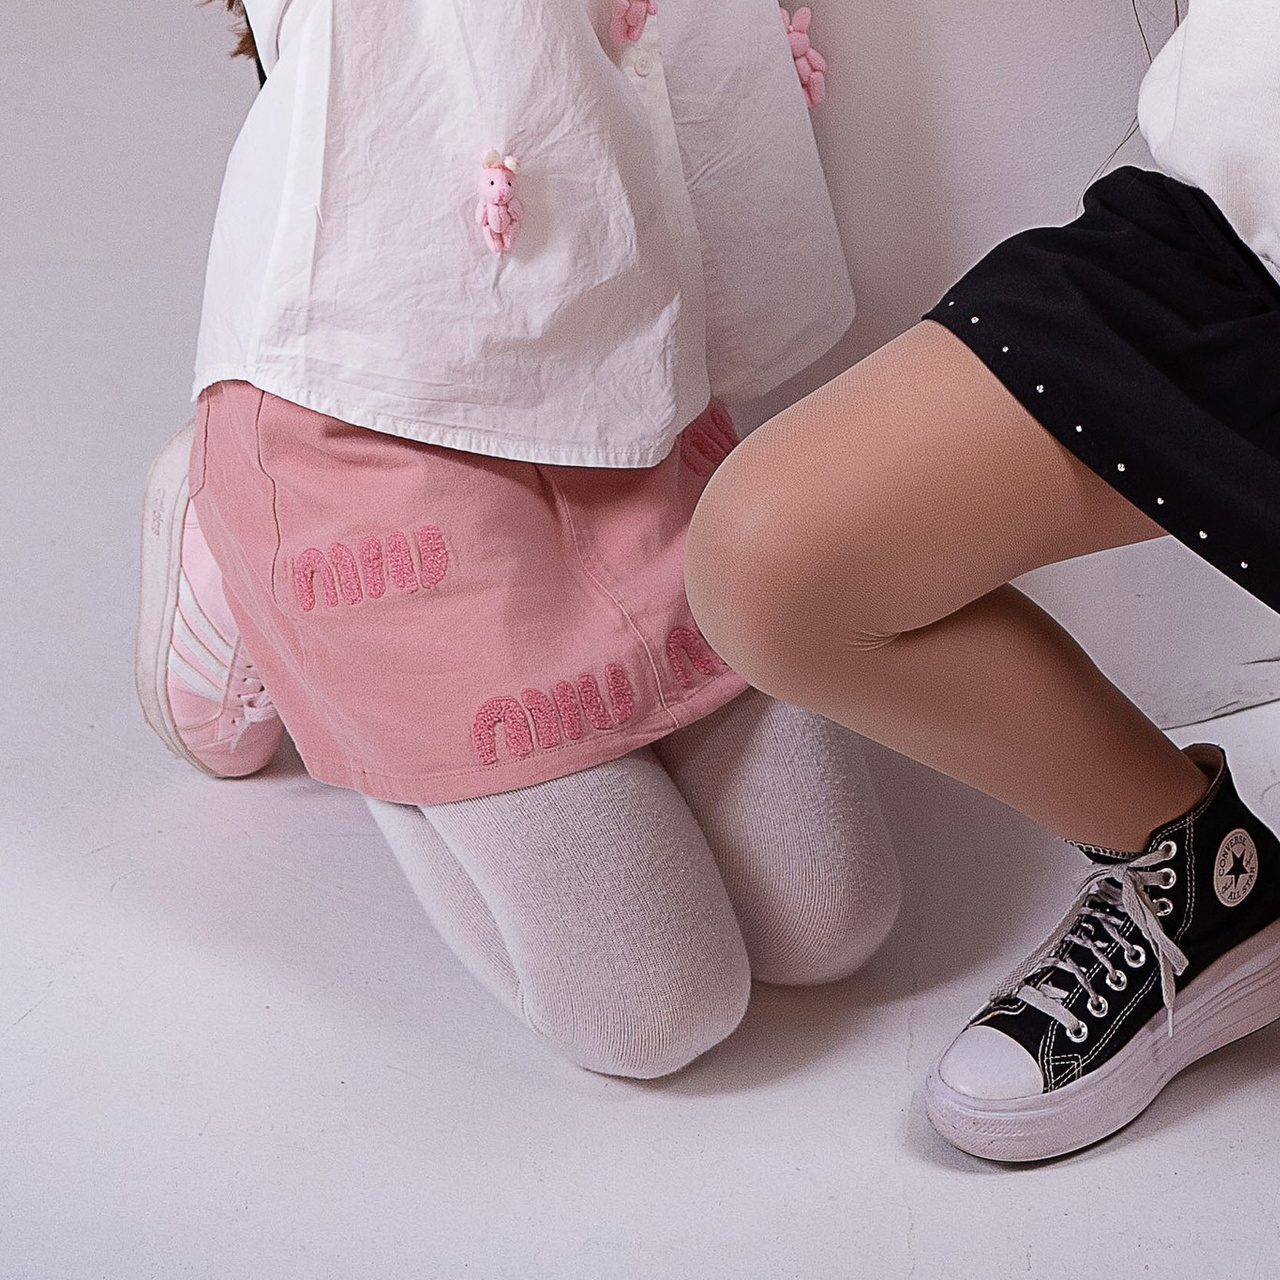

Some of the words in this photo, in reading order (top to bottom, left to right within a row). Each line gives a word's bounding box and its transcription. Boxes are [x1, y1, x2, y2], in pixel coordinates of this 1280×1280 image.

[1219, 835, 1247, 877] CONVERSE
[1227, 890, 1241, 900] ALL
[1241, 866, 1256, 894] STAR
